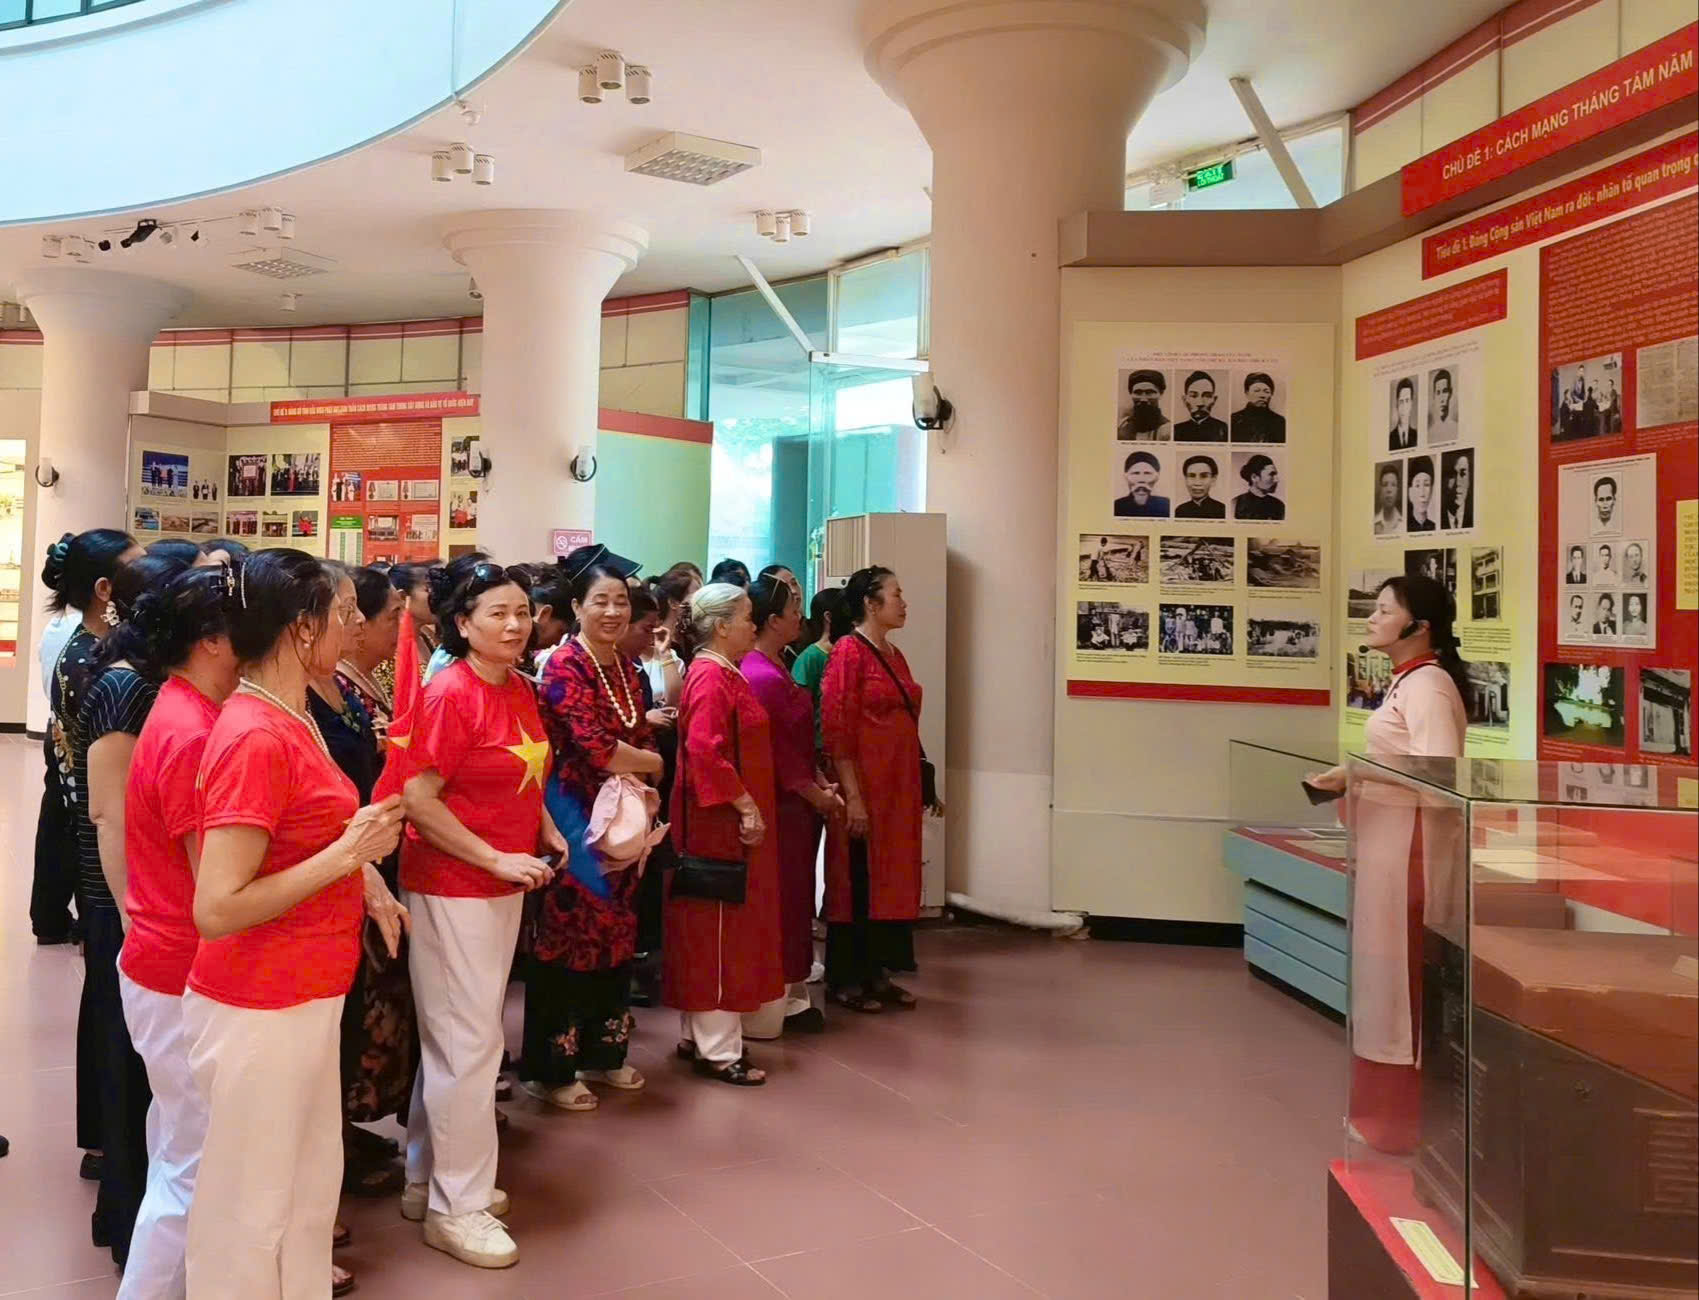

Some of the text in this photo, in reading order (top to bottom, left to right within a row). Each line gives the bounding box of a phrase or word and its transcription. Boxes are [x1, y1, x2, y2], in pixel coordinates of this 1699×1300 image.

[1484, 145, 1493, 160] 1:
[1496, 128, 1528, 155] CÁCH
[1531, 109, 1569, 140] MẠNG
[1572, 85, 1619, 120] THÁNG
[1623, 68, 1655, 97] TÁM
[1659, 50, 1693, 81] NĂM
[1525, 210, 1542, 228] Việt
[1544, 205, 1564, 221] Nam
[1565, 201, 1575, 214] ra
[1597, 182, 1620, 202] nhân
[1621, 173, 1633, 193] tố
[1634, 168, 1660, 192] quan
[1662, 156, 1691, 178] trọng
